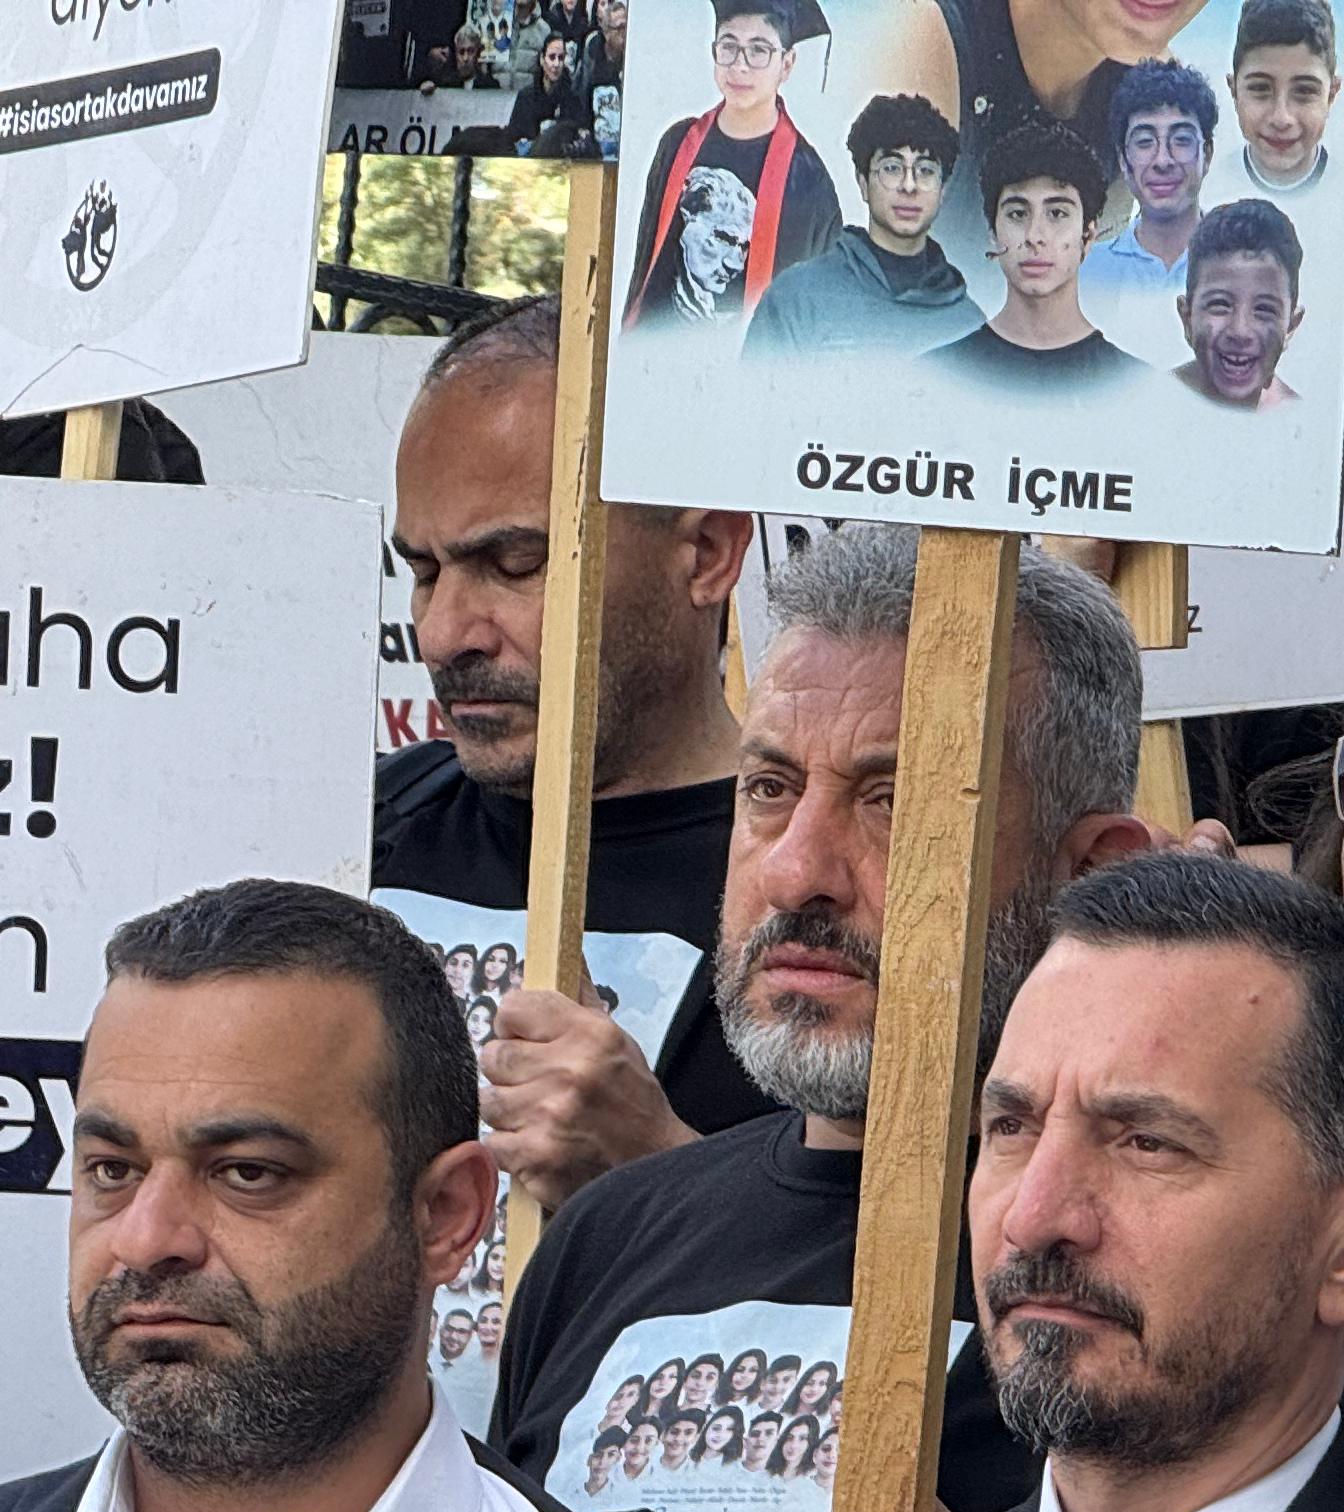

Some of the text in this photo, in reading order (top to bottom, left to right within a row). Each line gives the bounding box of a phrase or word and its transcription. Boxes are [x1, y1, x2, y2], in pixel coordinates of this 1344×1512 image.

[797, 442, 1133, 516] ÖZGÜR İÇME
[0, 587, 180, 693] ha
